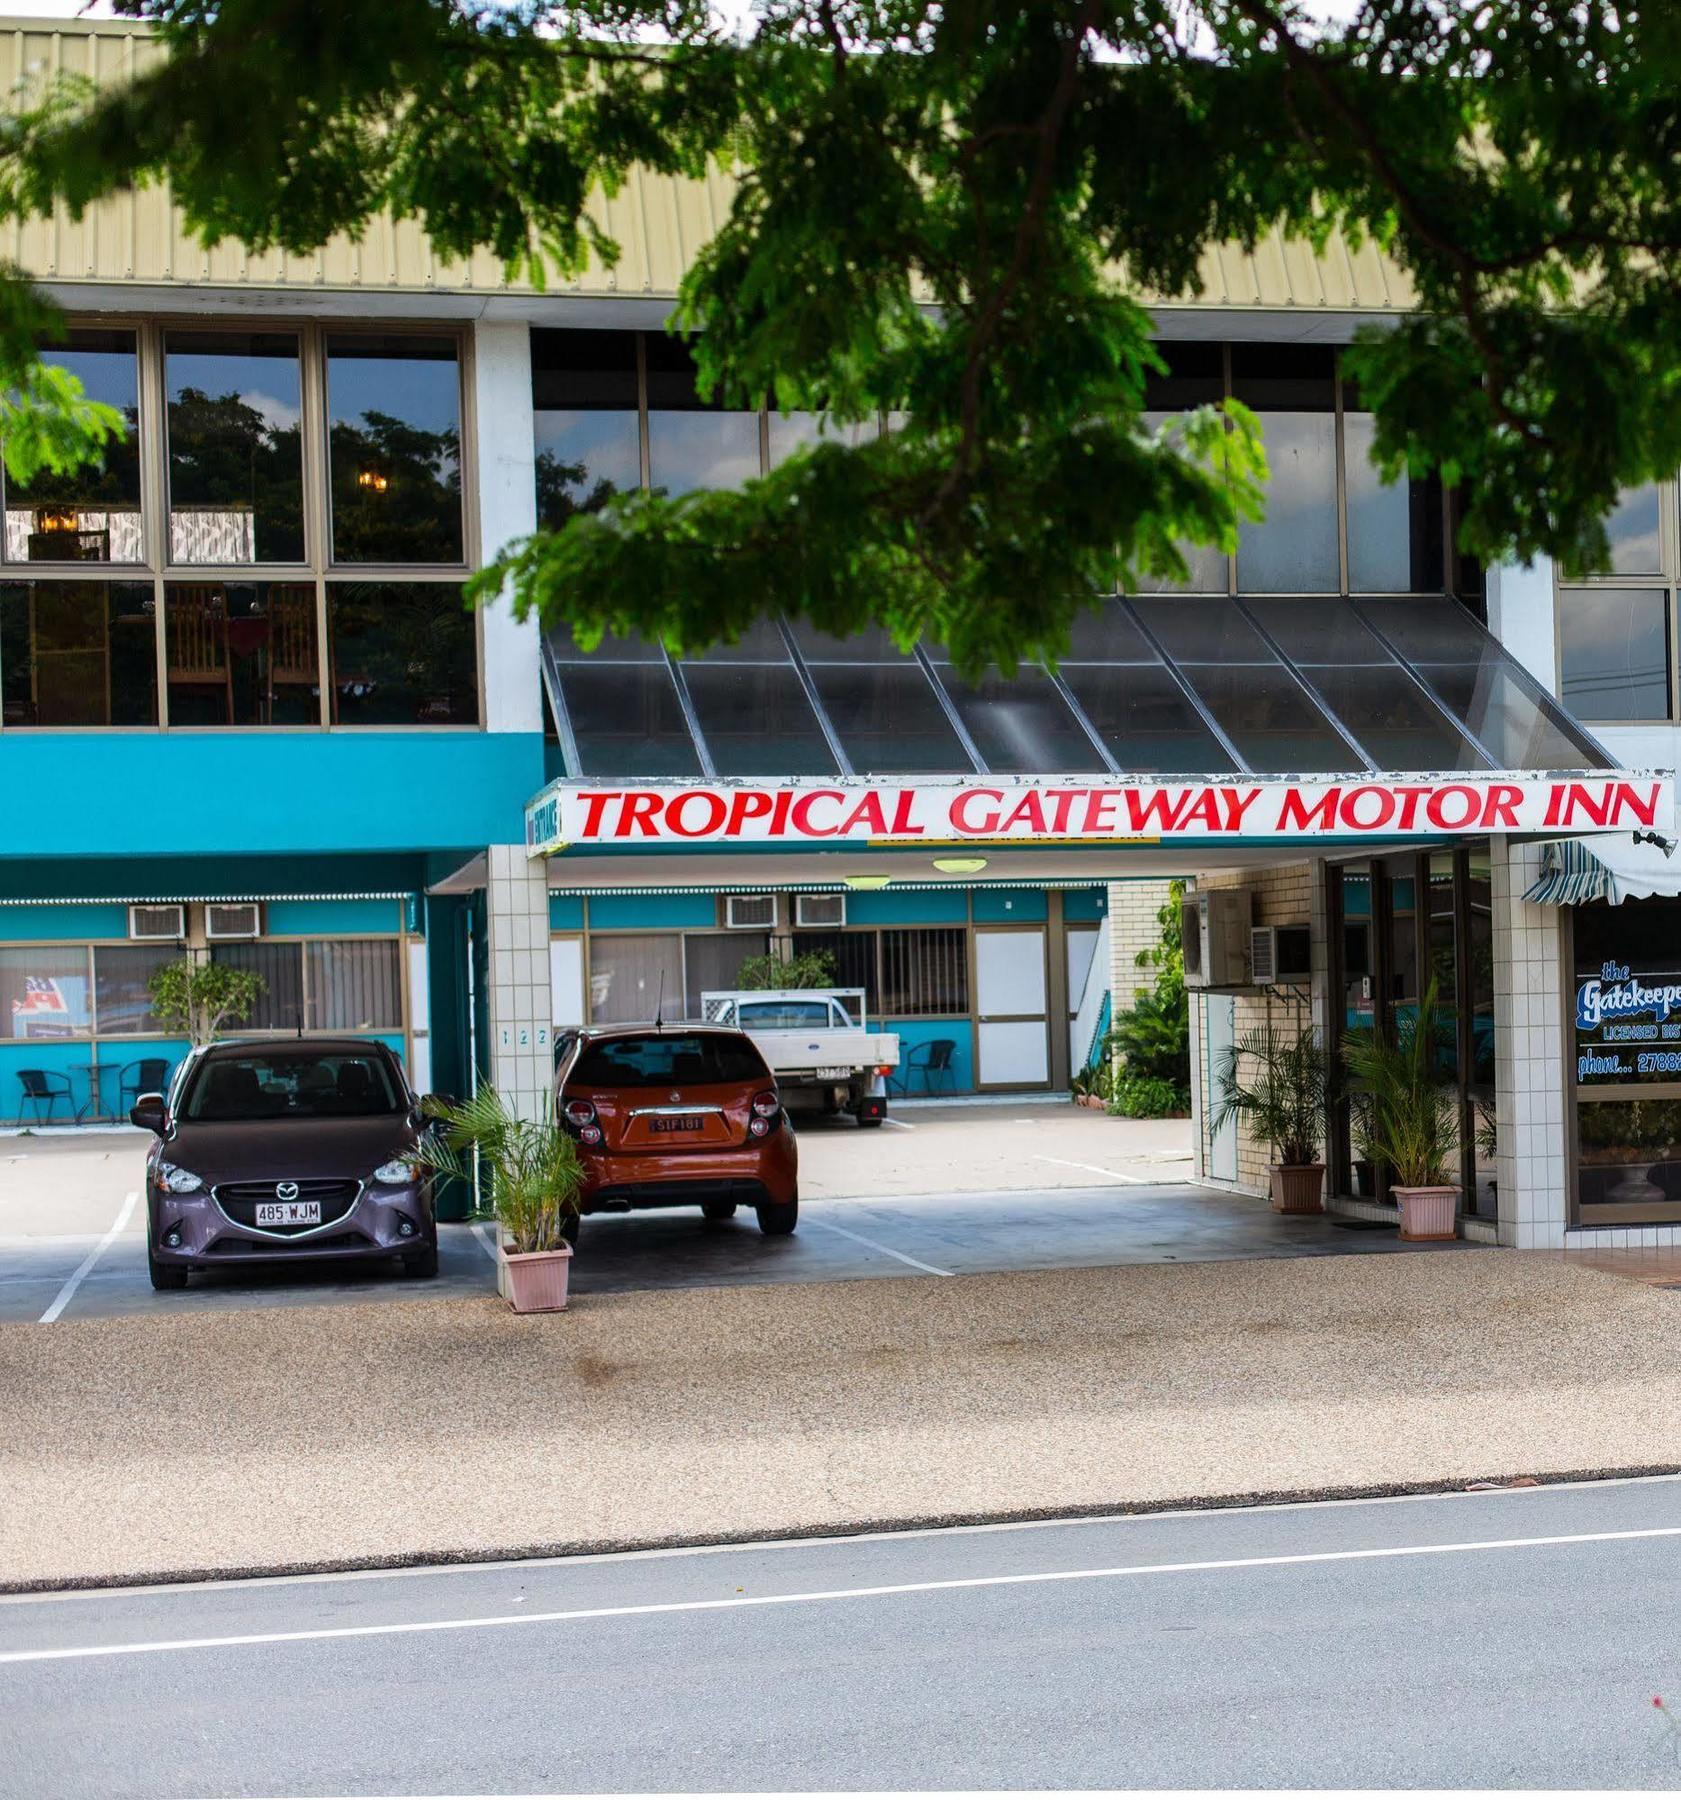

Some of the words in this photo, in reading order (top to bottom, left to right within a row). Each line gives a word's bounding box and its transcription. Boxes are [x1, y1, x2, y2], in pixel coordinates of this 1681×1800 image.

[577, 790, 925, 837] TROPICAL
[949, 788, 1263, 834] GATEWAY
[1275, 785, 1525, 831] MOTOR
[1543, 783, 1661, 826] INN
[1601, 960, 1630, 981] the
[1603, 1025, 1658, 1041] LICENSED
[1661, 1024, 1681, 1038] BIS
